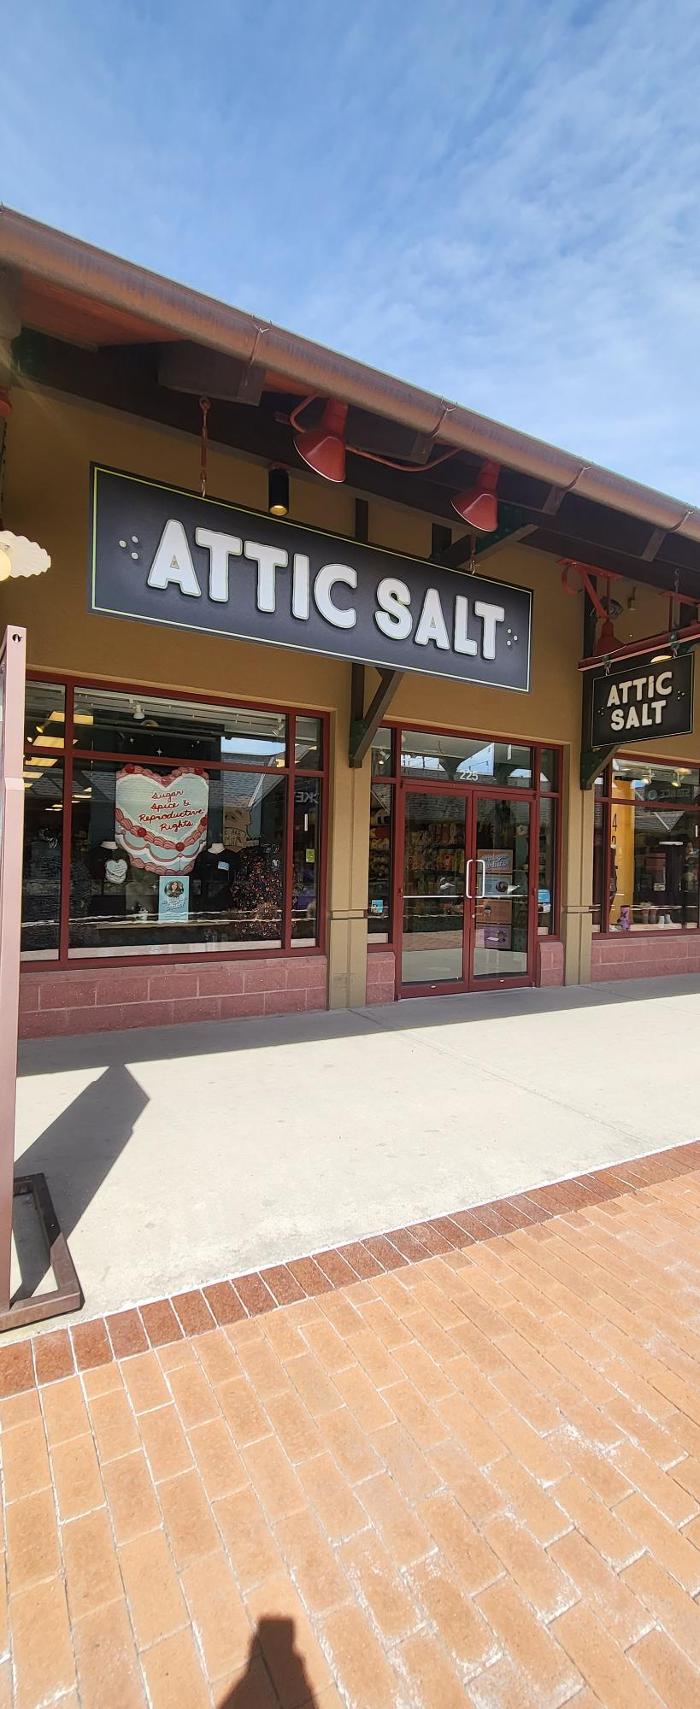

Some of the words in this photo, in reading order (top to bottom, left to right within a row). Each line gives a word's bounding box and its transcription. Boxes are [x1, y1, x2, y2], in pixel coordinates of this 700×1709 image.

[146, 518, 359, 630] ATTIC
[373, 576, 505, 661] SALT
[607, 671, 673, 708] ATTIC
[610, 700, 667, 731] SALT
[459, 770, 479, 782] 225
[138, 809, 204, 823] Reproductive
[160, 820, 193, 833] Rights
